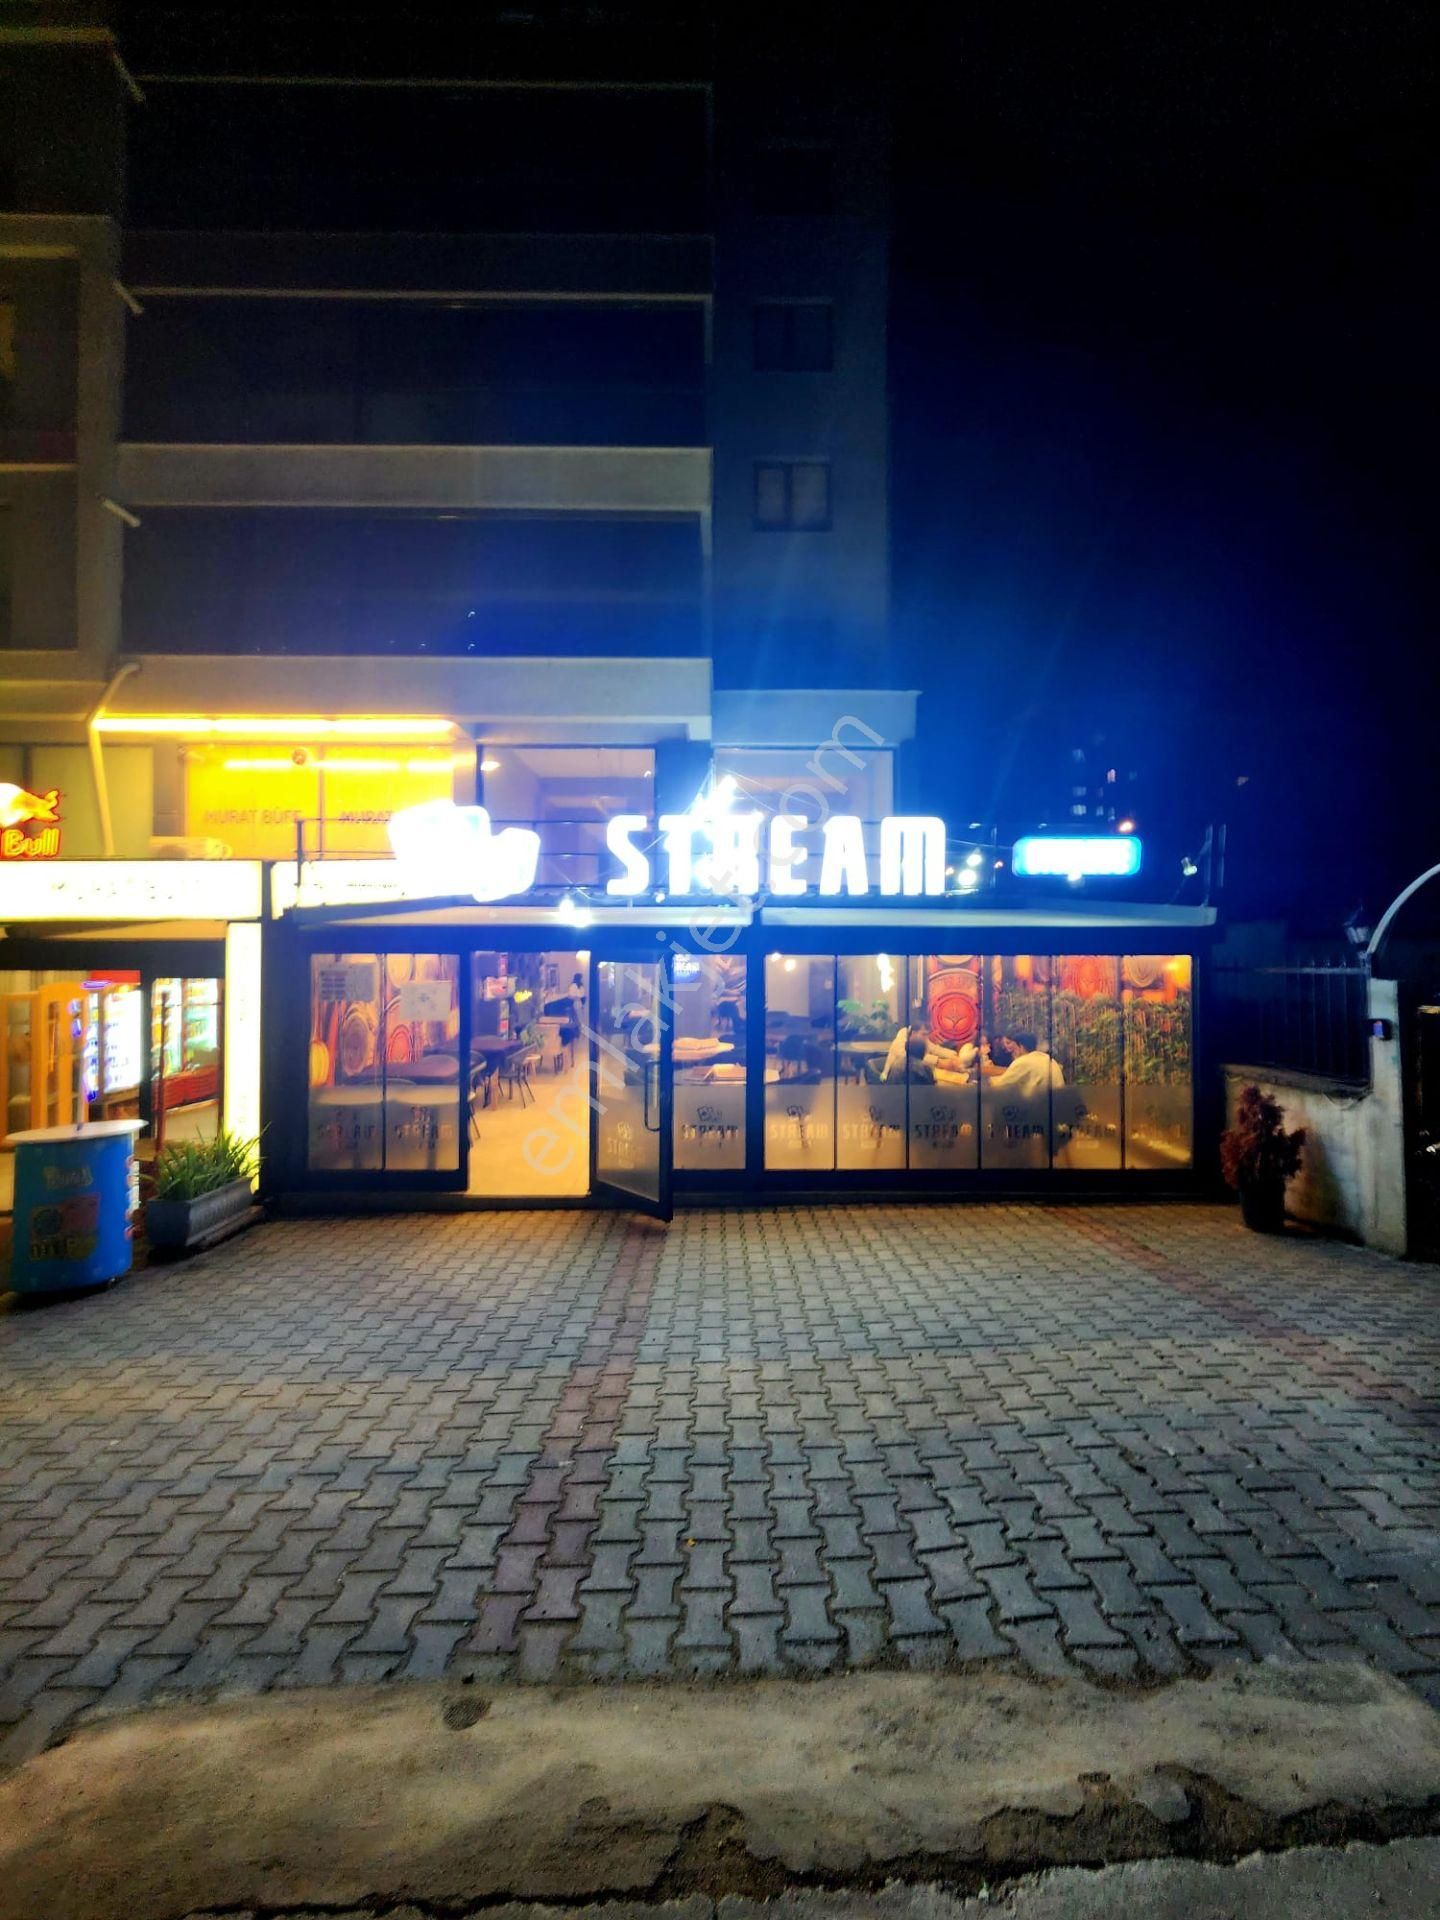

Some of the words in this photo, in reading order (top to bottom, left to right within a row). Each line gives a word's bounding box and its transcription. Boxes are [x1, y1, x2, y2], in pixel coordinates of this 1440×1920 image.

[203, 808, 258, 824] MURAT
[3, 827, 60, 857] Bull
[606, 814, 947, 896] STREAM
